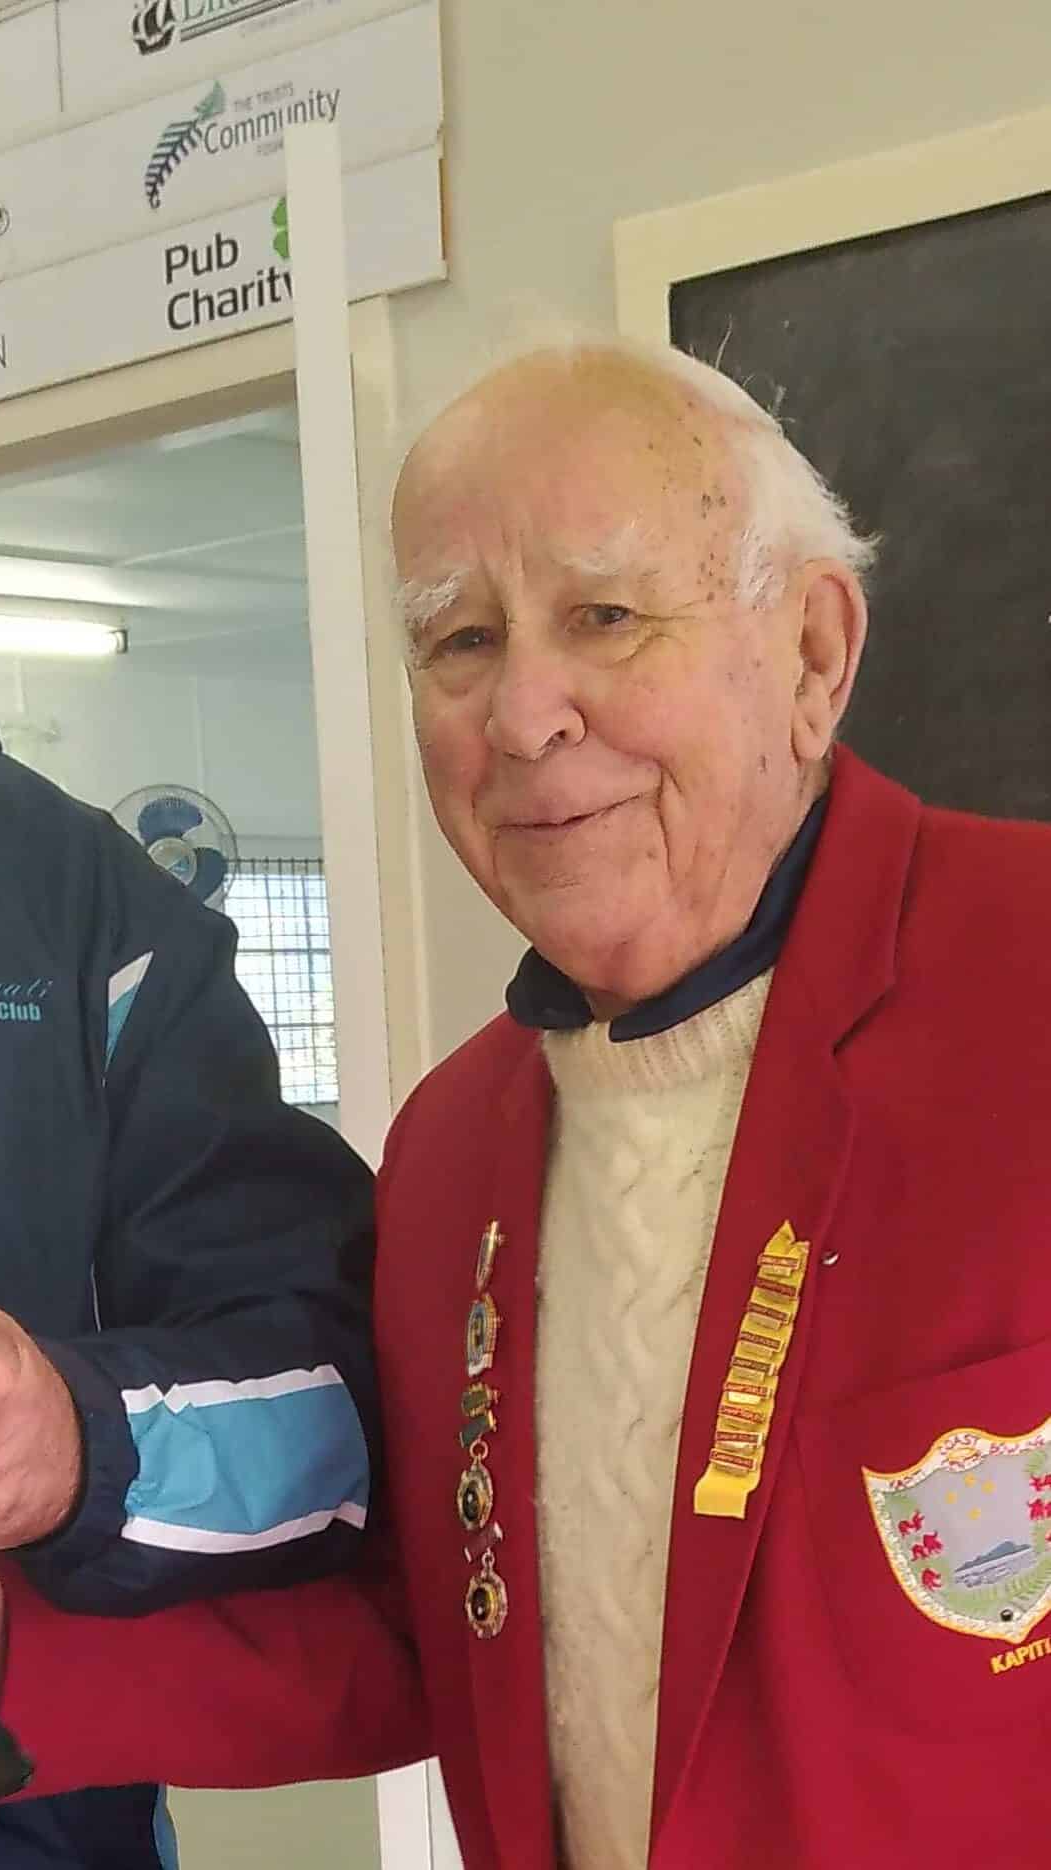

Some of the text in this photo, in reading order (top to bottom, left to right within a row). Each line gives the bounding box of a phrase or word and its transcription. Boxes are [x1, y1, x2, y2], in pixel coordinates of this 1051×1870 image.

[203, 88, 340, 154] Community
[165, 233, 239, 285] Pub
[990, 1638, 1051, 1674] KAPITI
